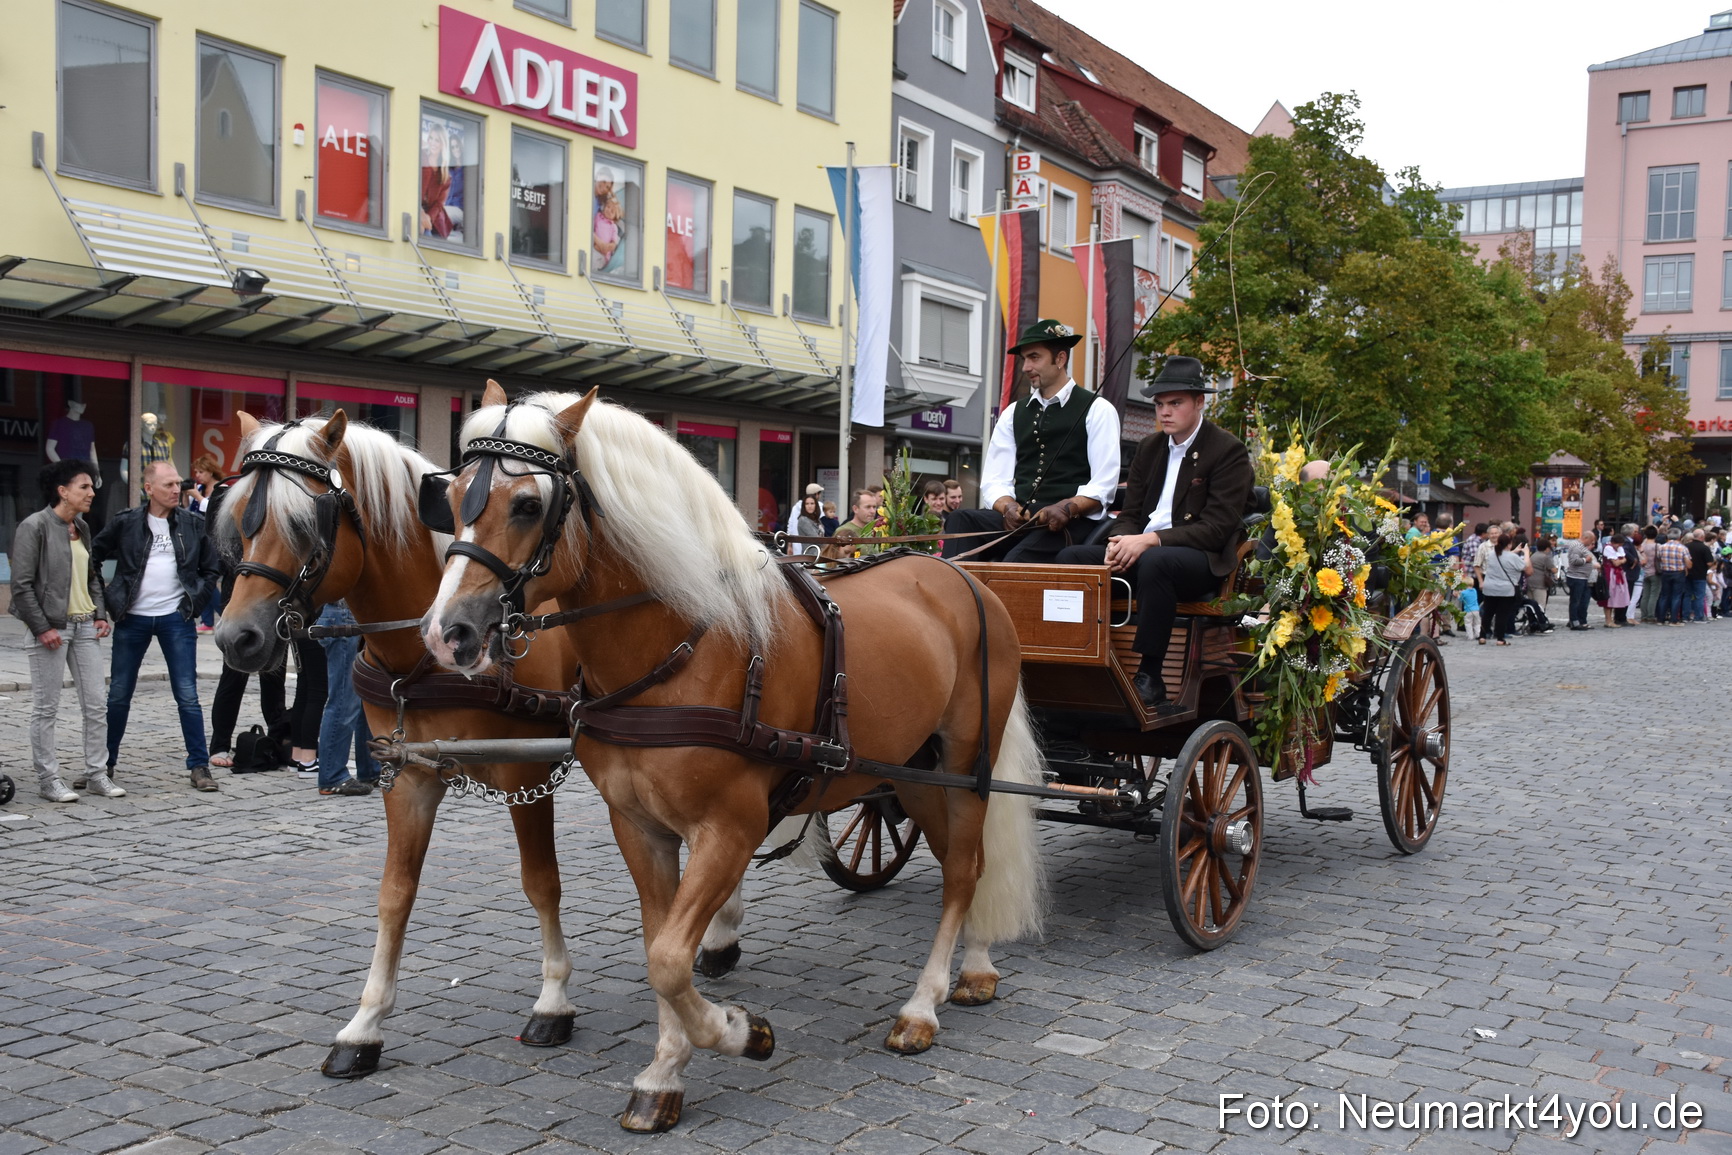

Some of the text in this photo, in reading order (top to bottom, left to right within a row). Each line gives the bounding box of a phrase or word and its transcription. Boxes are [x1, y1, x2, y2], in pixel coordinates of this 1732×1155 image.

[460, 22, 629, 138] ADLER
[322, 124, 367, 158] ALE
[524, 190, 546, 206] SEITE
